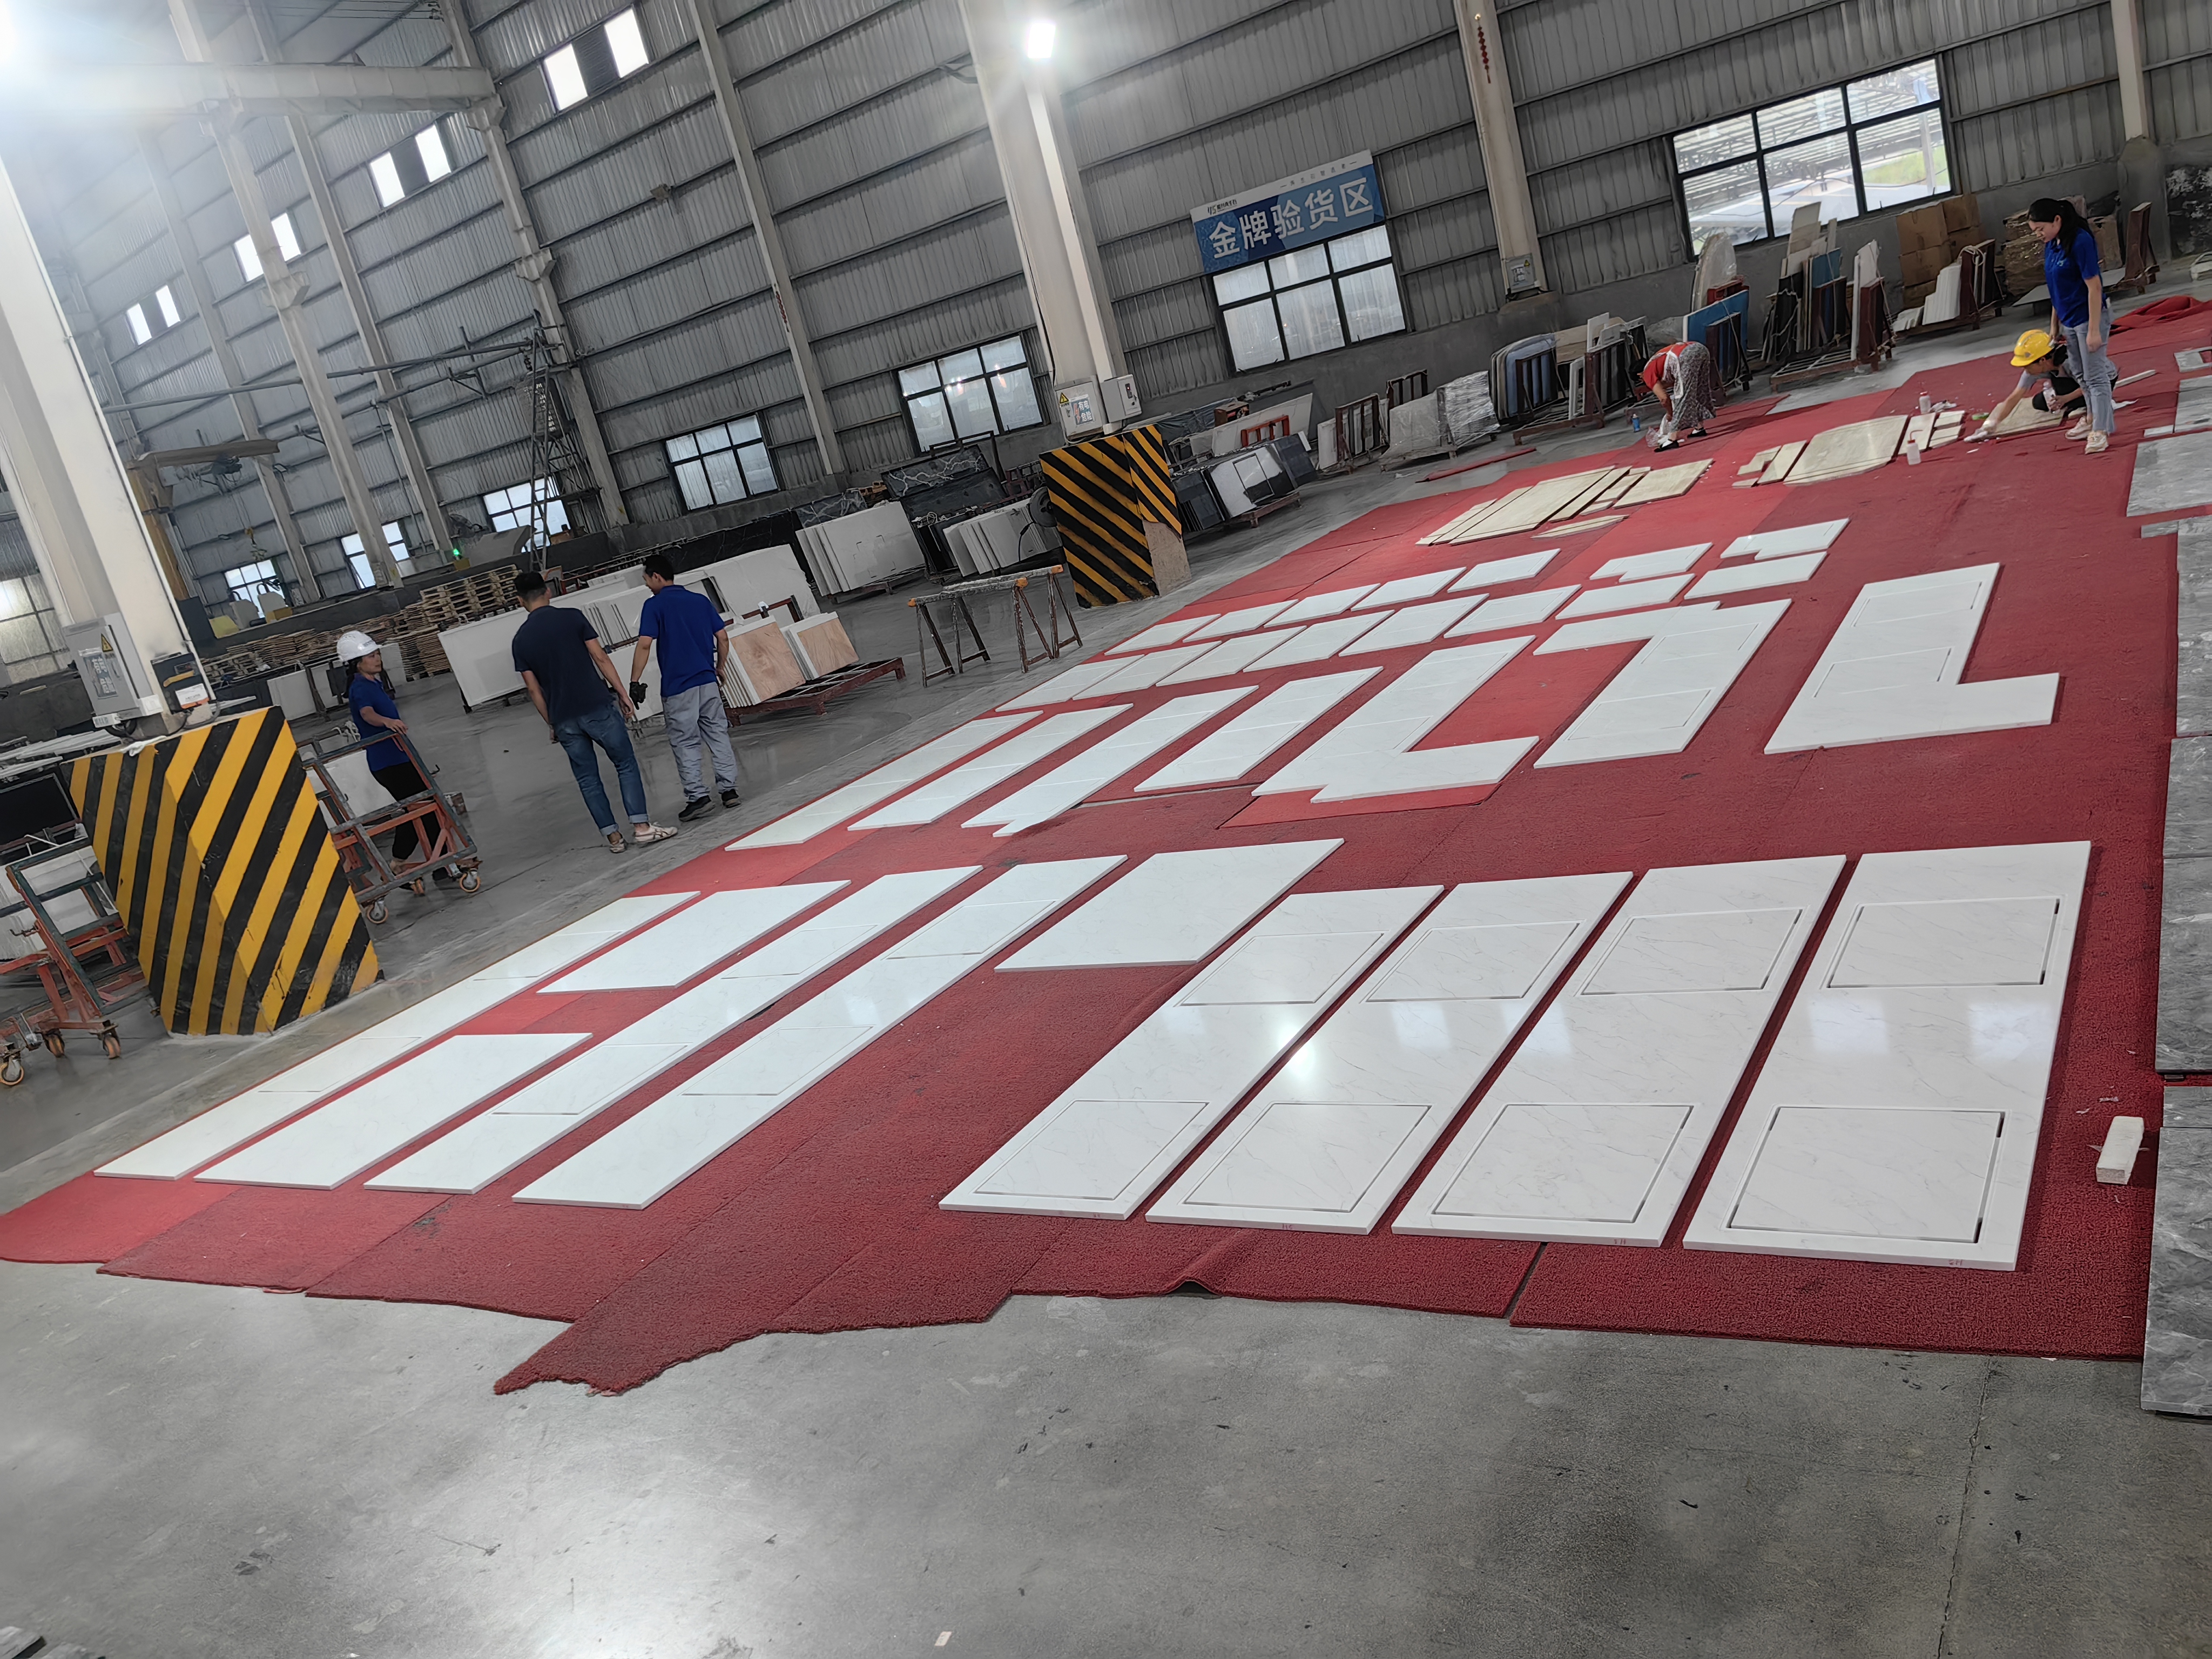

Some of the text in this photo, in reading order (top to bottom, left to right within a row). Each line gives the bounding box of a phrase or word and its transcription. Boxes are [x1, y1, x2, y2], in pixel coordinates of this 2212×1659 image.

[1209, 177, 1373, 259] 金牌验货区
